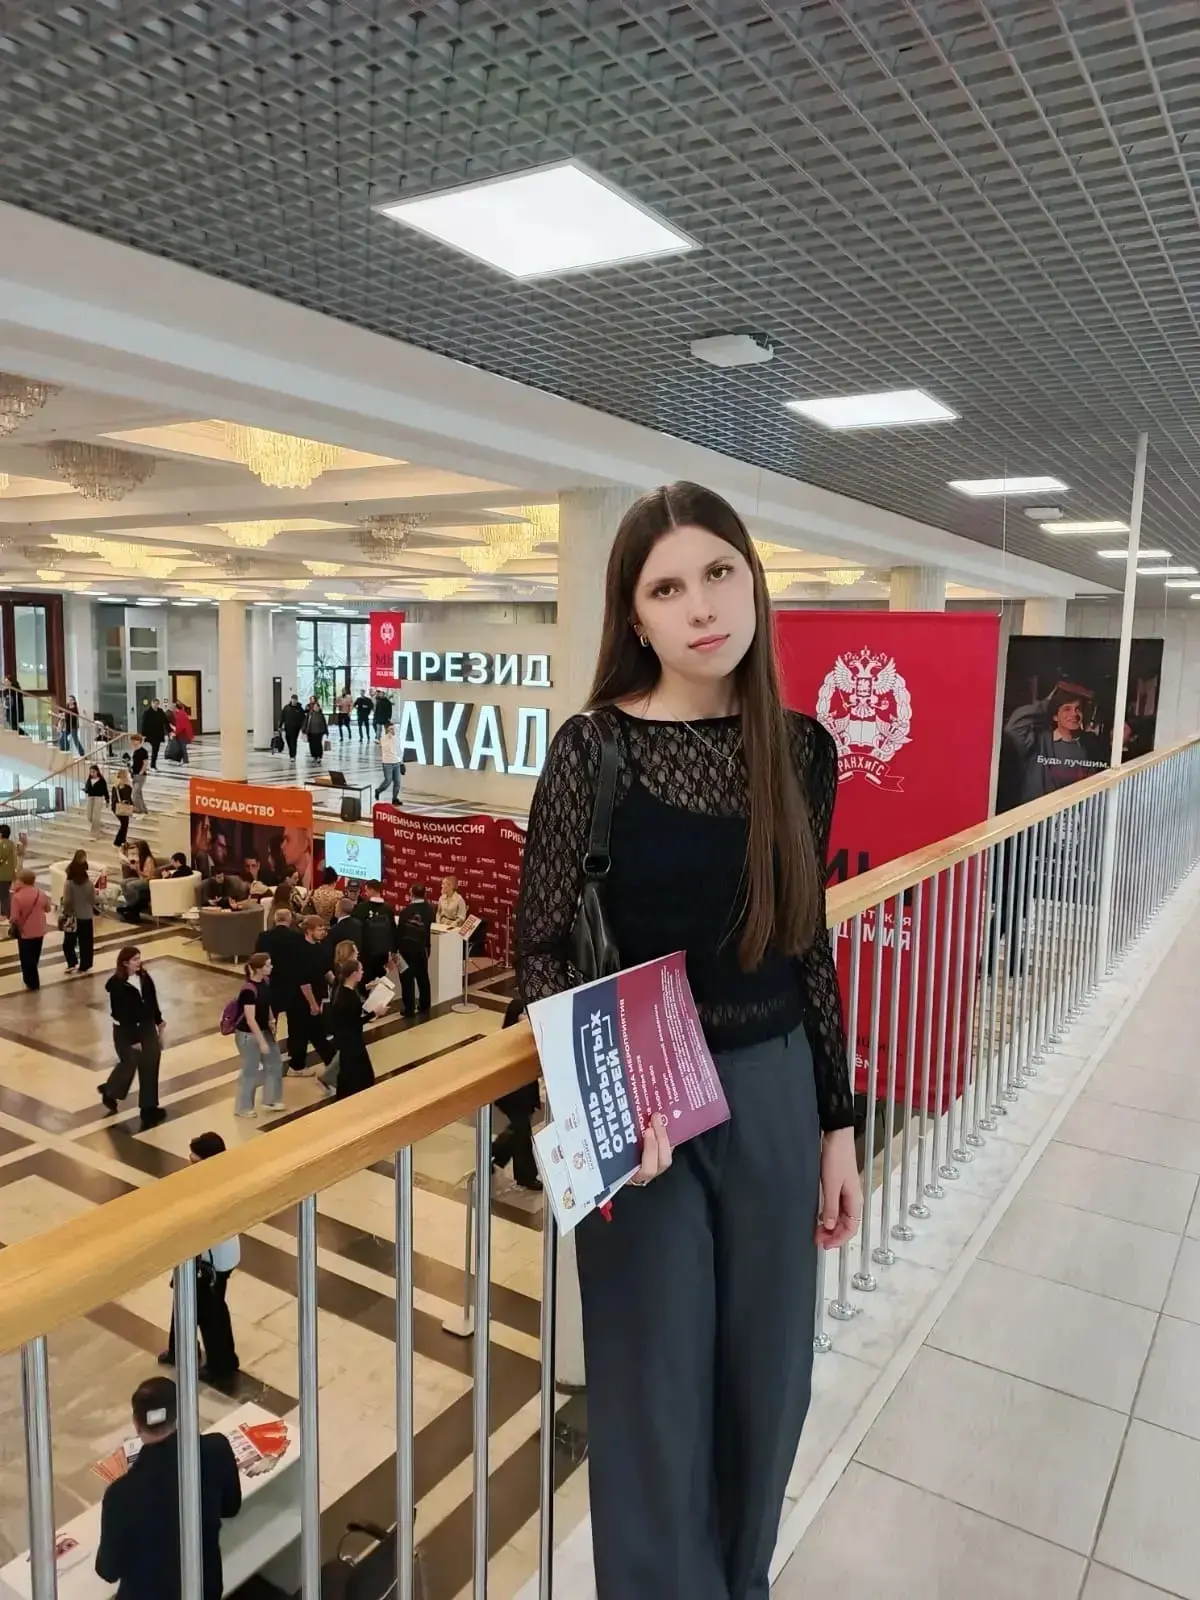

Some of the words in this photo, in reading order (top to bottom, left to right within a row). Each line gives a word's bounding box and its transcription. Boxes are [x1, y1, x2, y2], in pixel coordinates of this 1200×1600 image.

[393, 650, 552, 687] ПРЕЗИД
[399, 700, 549, 776] АКАД
[837, 756, 885, 776] РАНХиГС
[1036, 755, 1062, 766] Будь
[1063, 758, 1110, 769] лучшим.
[195, 795, 275, 818] ГОСУДАРСТВО
[375, 811, 421, 830] ПРИЕМНАЯ
[423, 822, 485, 835] КОМИССИЯ
[393, 828, 414, 840] ИГСУ
[416, 833, 463, 846] РАНХиГС
[590, 1009, 624, 1153] ОТКРЫТЫХ
[607, 1048, 638, 1144] ДВЕРЕЙ
[588, 1091, 614, 1160] ДЕНЬ
